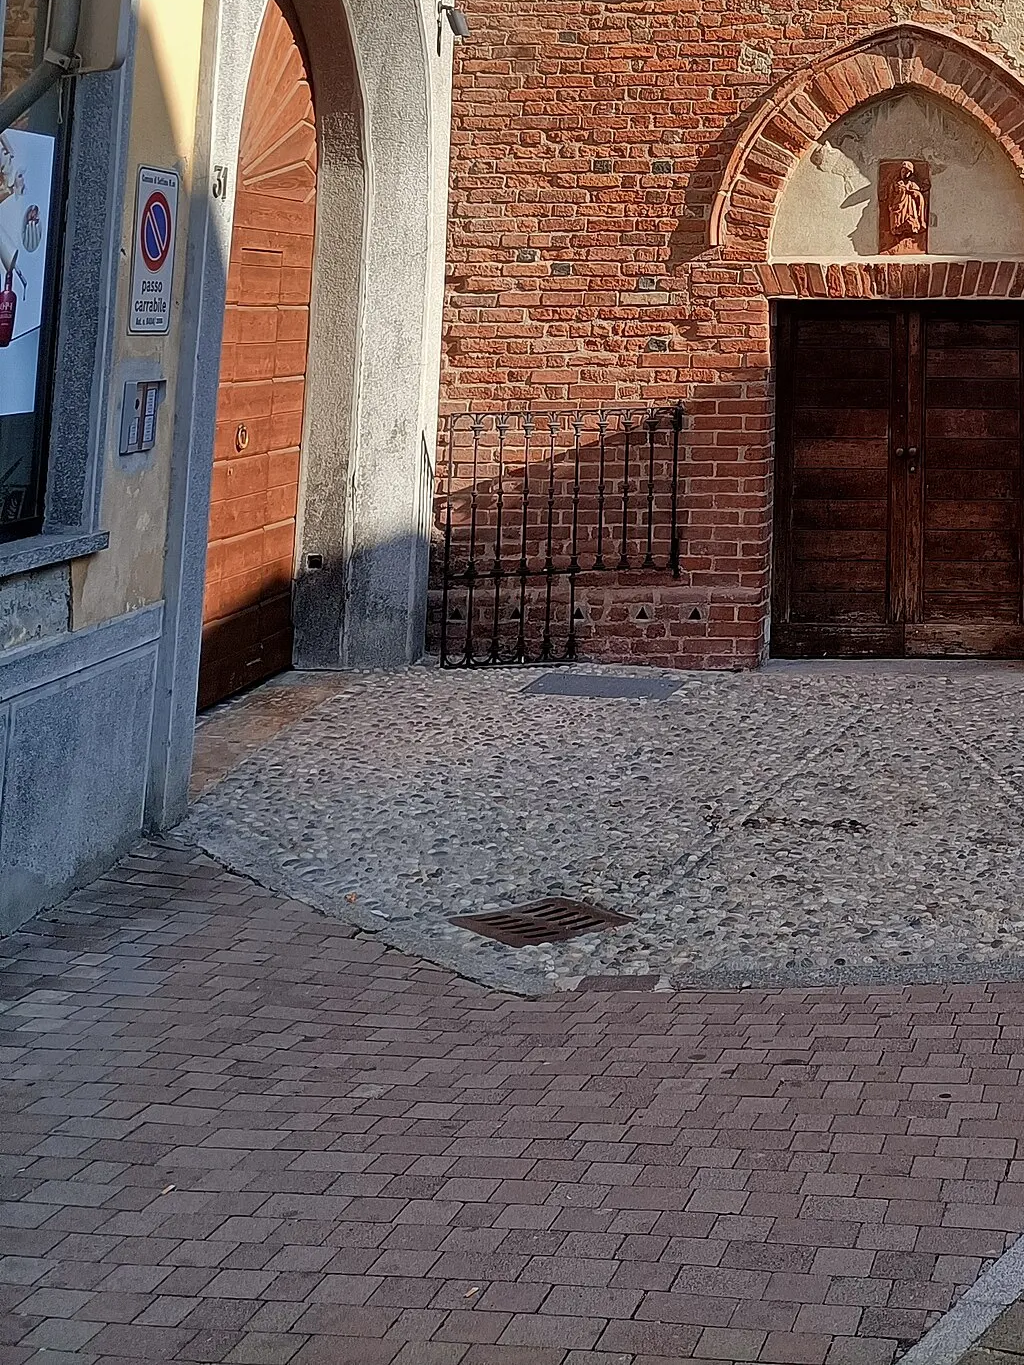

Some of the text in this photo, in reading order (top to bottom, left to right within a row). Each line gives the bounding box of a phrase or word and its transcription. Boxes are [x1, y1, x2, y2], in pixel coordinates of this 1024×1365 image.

[212, 165, 228, 200] 31
[142, 280, 162, 294] passo
[135, 298, 166, 312] carrabile
